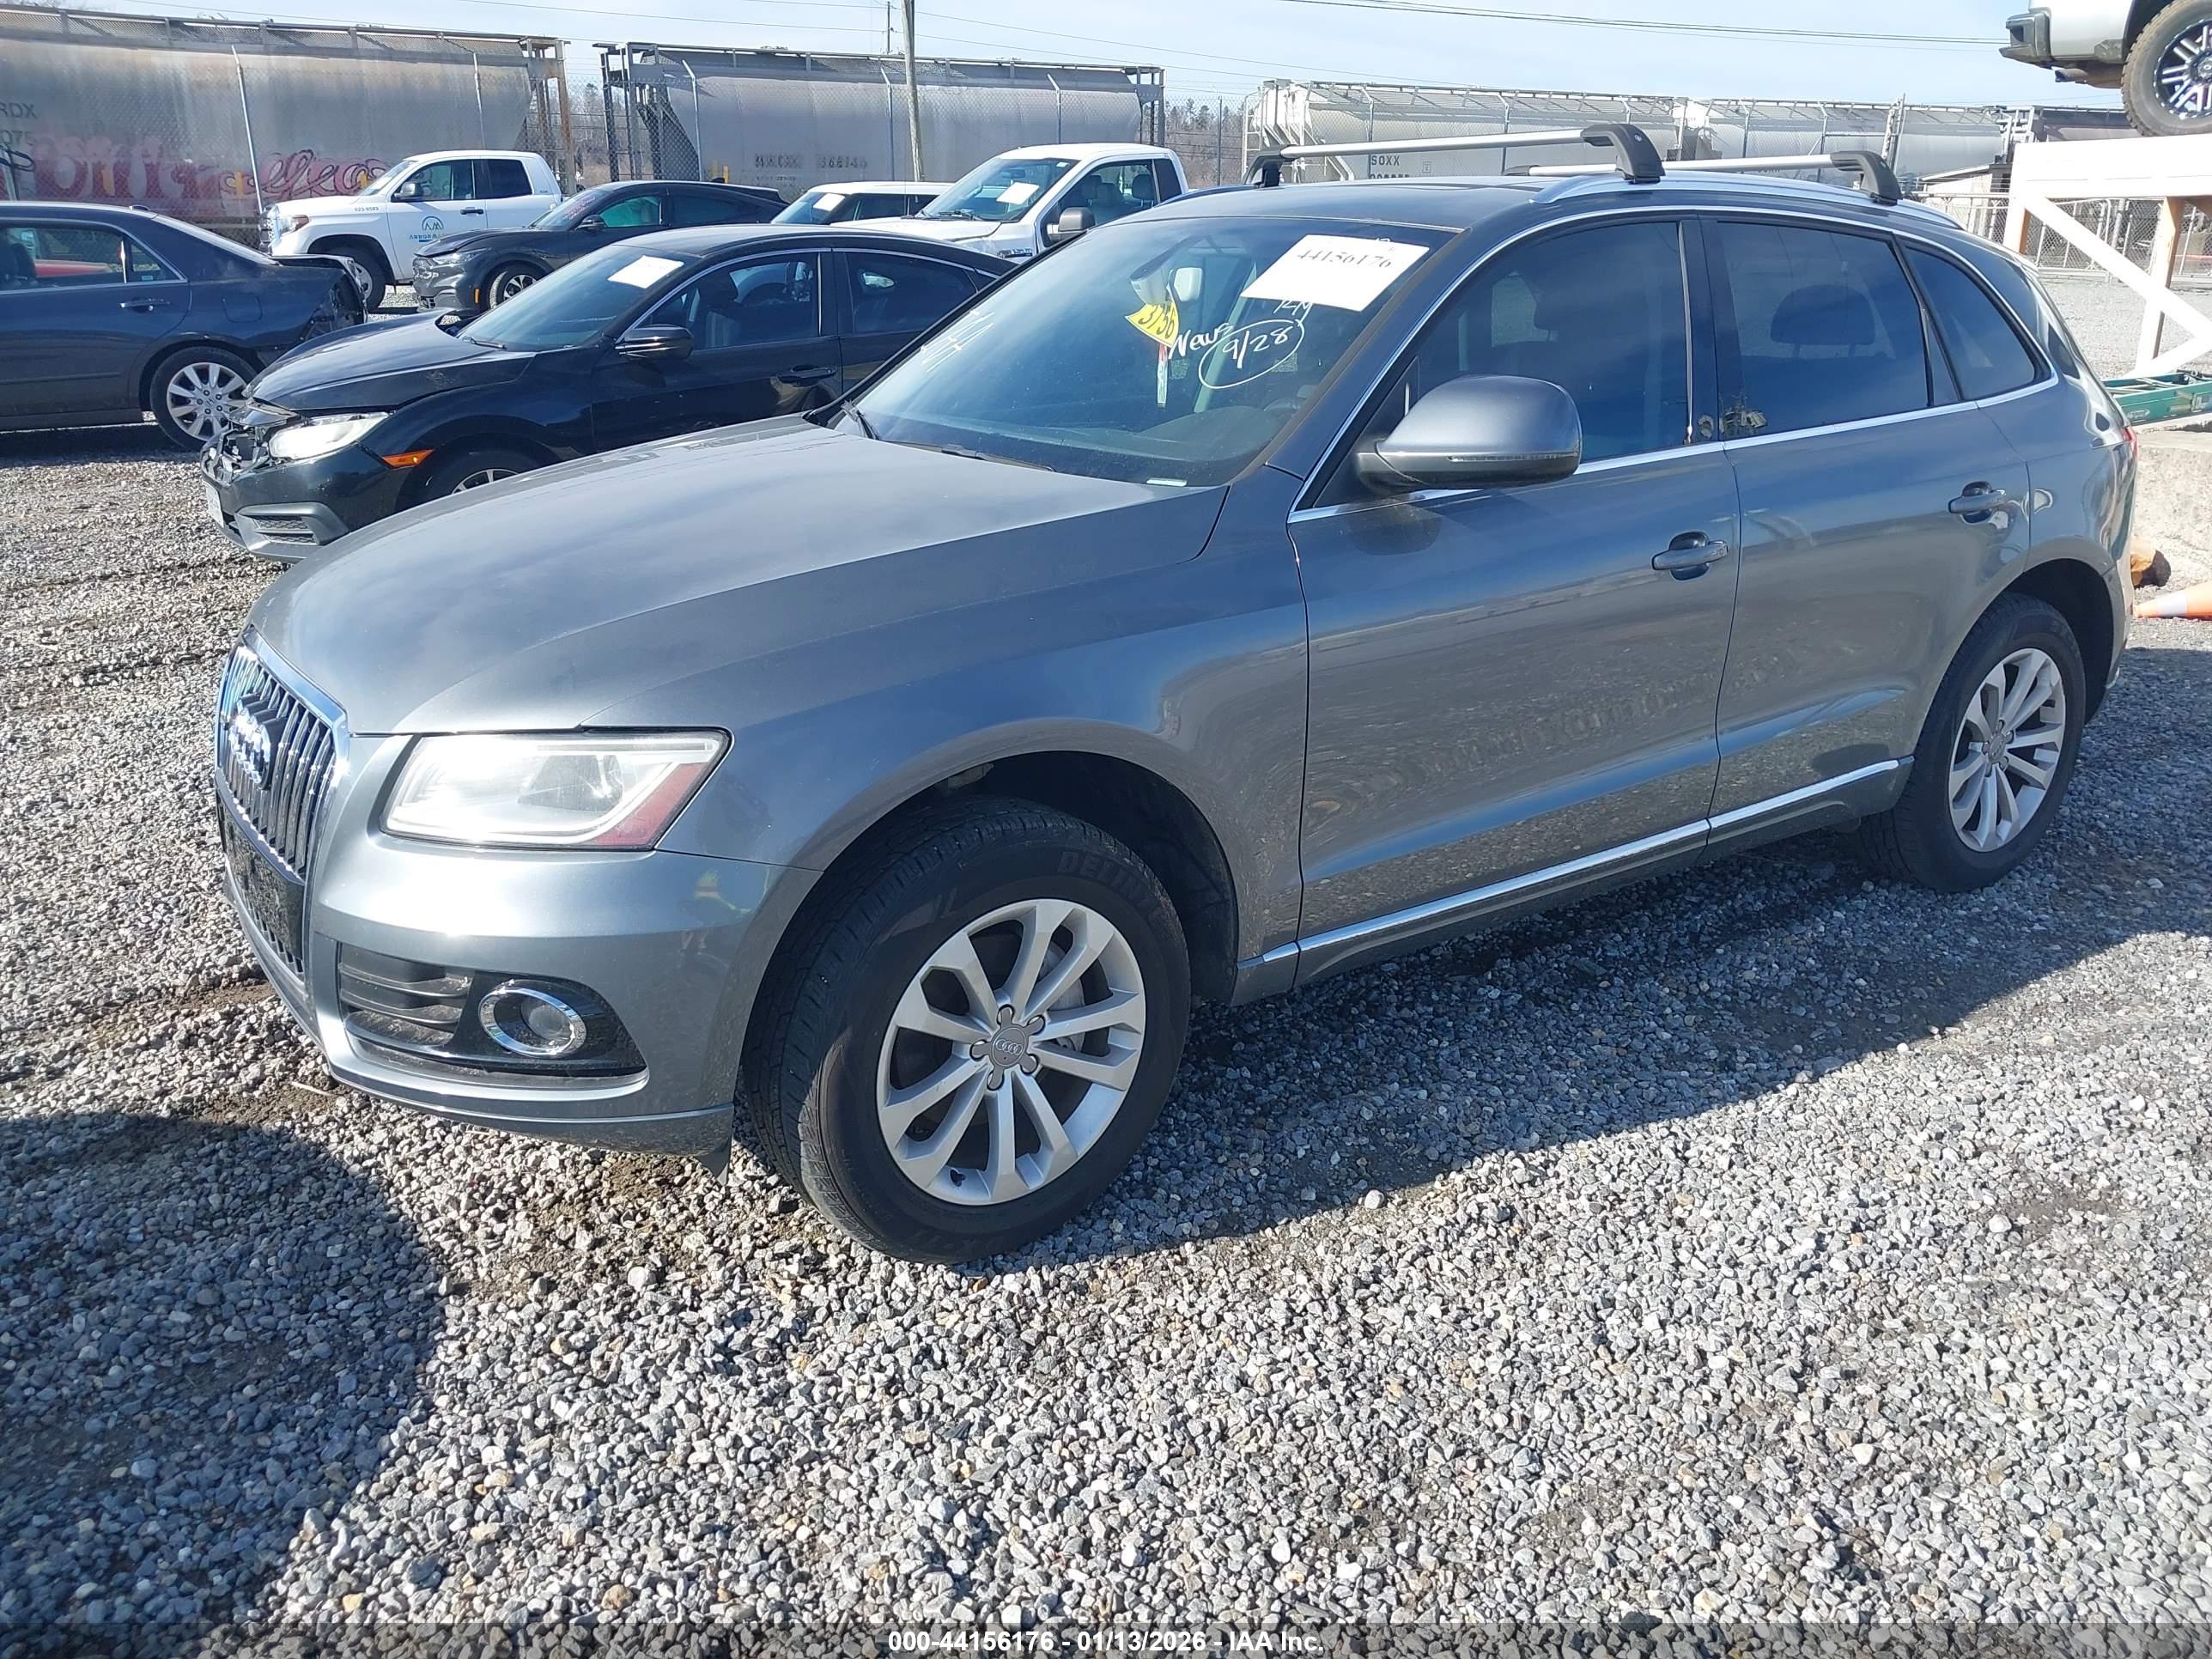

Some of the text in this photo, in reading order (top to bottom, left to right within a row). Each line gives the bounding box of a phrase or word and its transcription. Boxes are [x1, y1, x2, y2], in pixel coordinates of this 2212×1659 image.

[1370, 155, 1401, 166] SOXX
[1297, 249, 1392, 268] 44156176
[1222, 325, 1294, 369] 9/28
